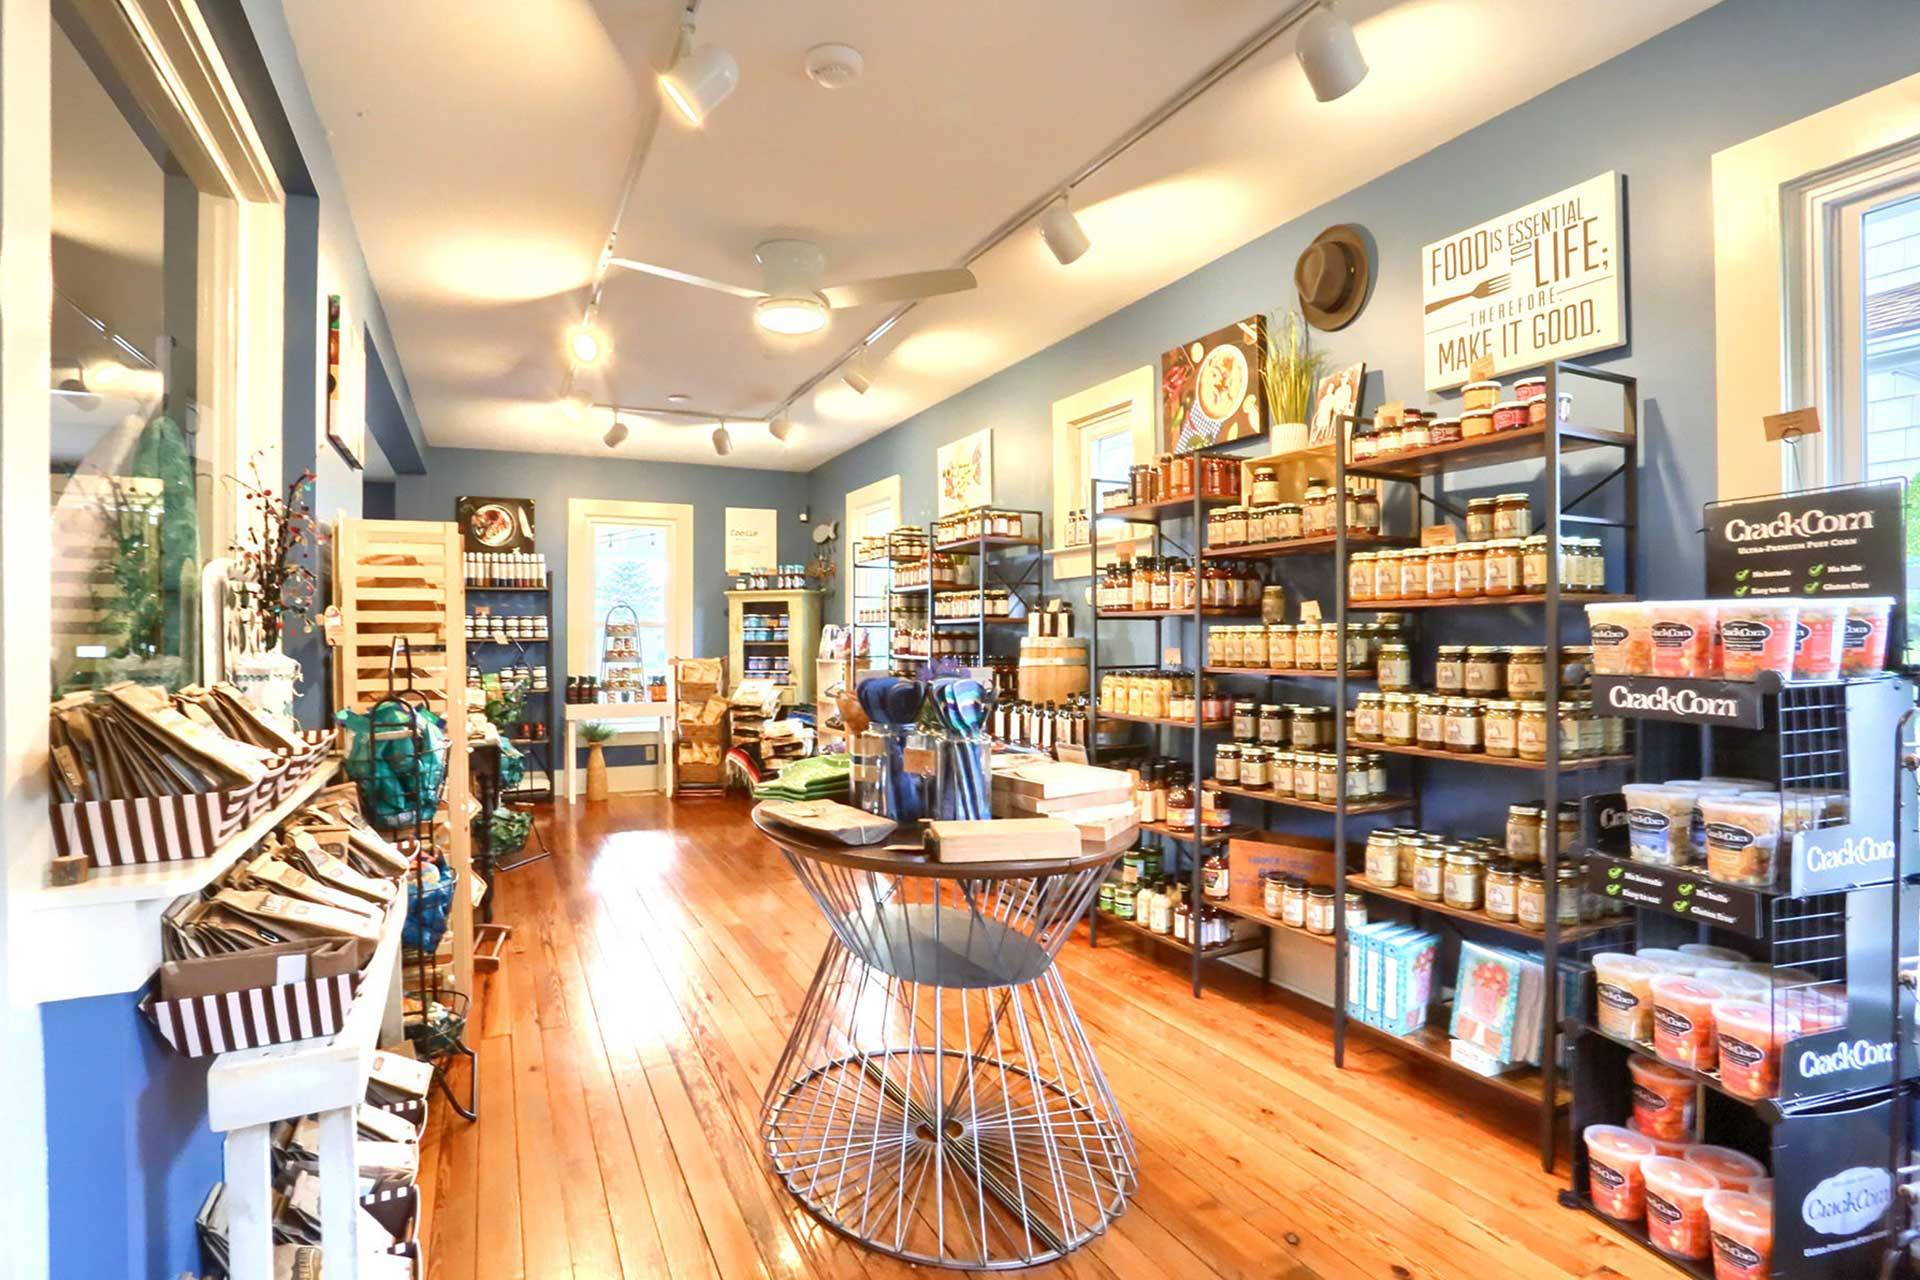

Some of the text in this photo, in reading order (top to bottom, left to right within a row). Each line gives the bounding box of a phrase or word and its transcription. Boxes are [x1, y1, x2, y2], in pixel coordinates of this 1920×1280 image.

[1432, 197, 1584, 286] FOOD IS ESSENTIAL
[1510, 216, 1609, 288] TO LIFE;
[1438, 298, 1601, 376] MAKE IT GOOD.
[1724, 509, 1875, 543] CrackCorn
[1609, 685, 1737, 717] CrackCorn
